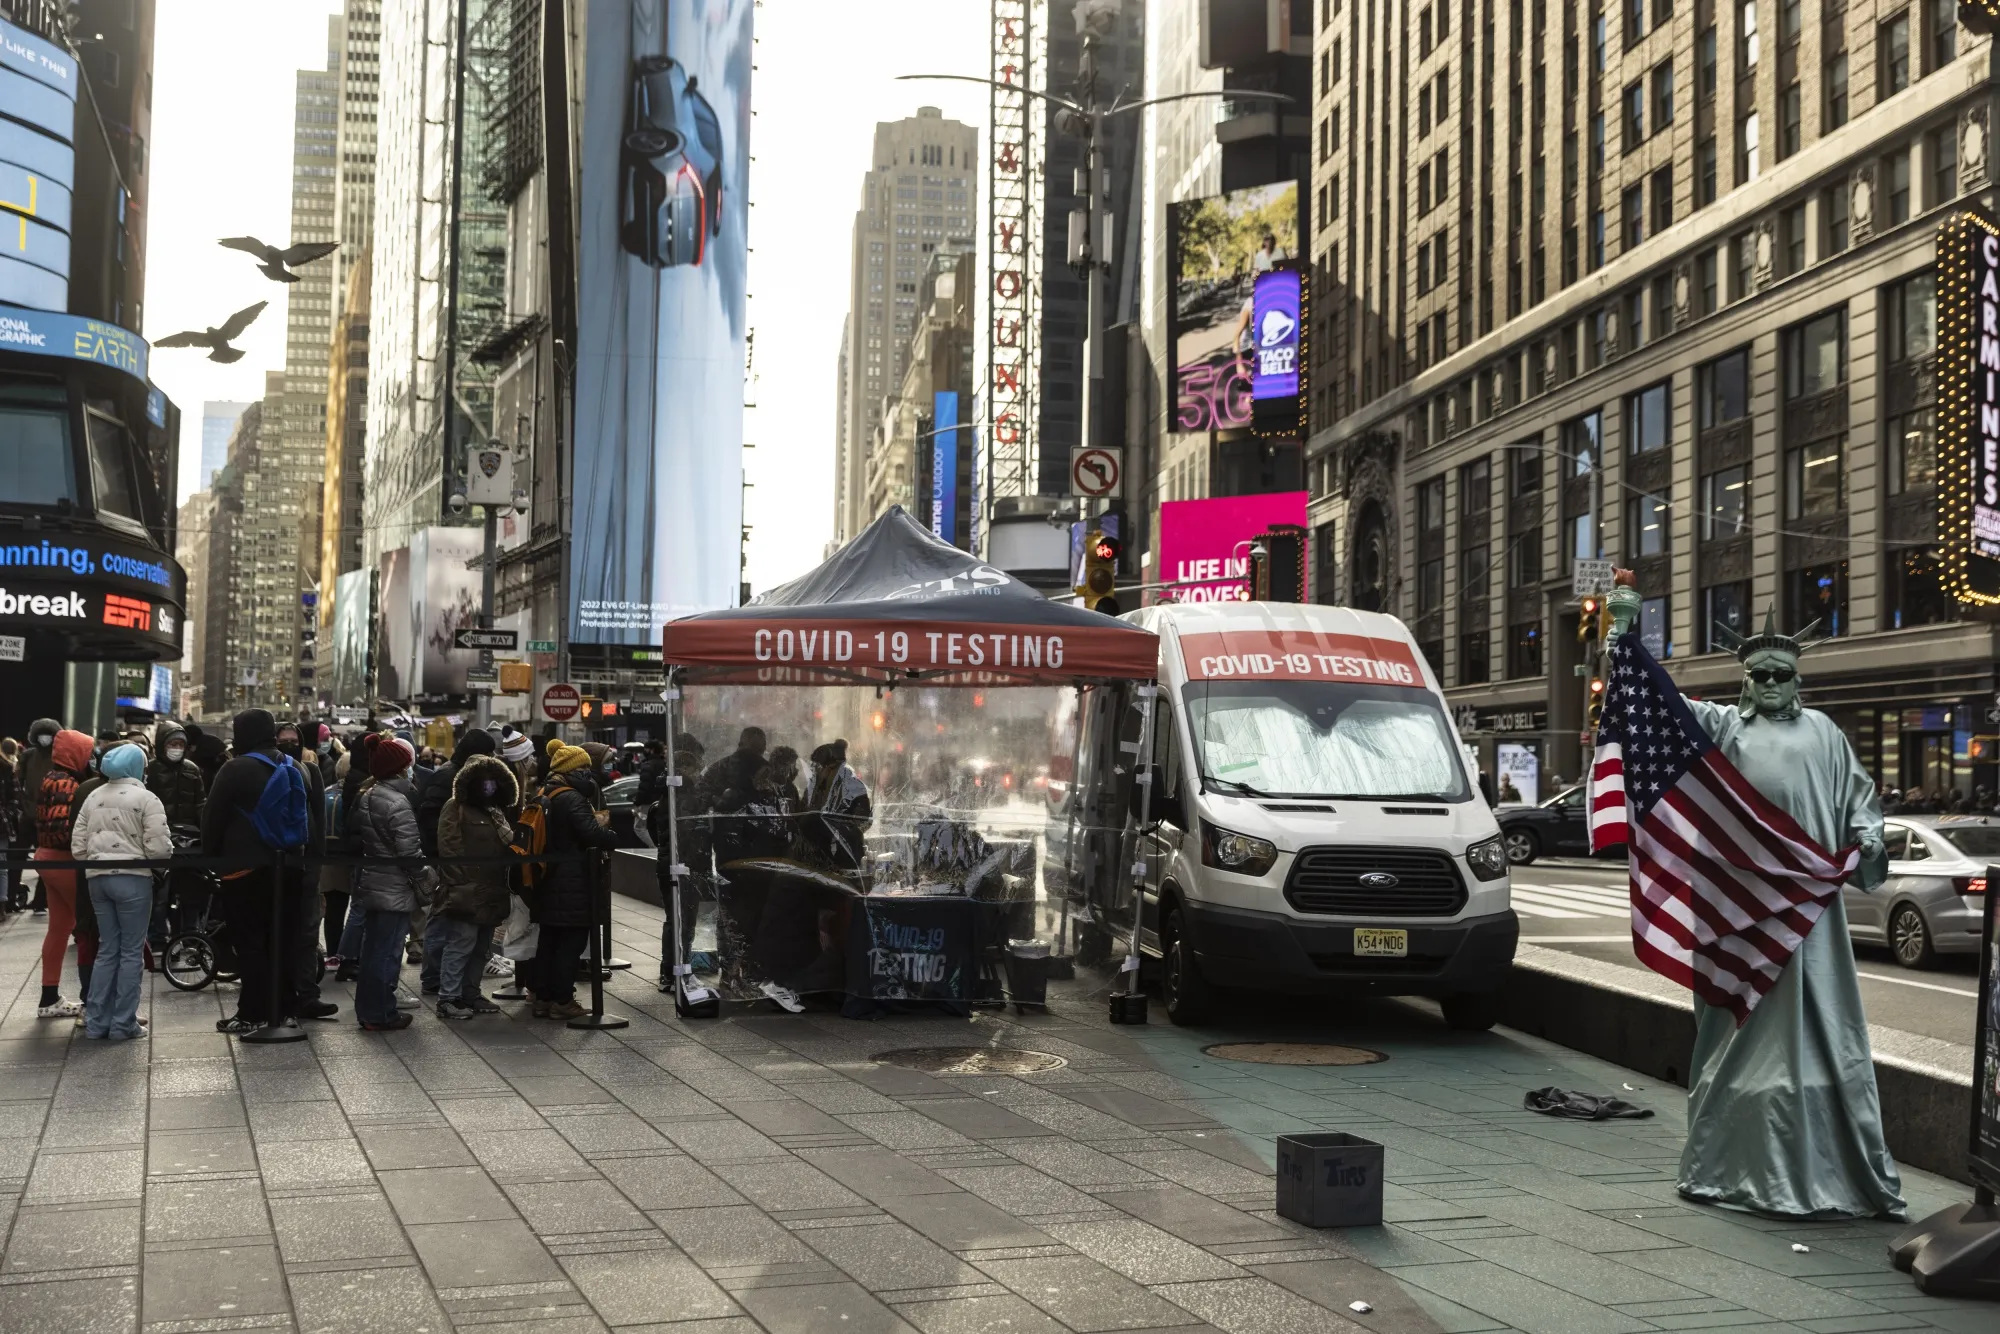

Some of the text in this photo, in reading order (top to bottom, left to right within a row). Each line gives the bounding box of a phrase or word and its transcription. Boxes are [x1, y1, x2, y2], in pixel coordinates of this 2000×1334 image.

[6, 38, 36, 62] LIKE
[40, 55, 67, 78] THIS
[996, 221, 1020, 443] YOUNG
[75, 331, 138, 373] EARTH
[1258, 346, 1294, 363] TACO
[1261, 358, 1294, 376] BELL
[1178, 360, 1253, 432] 5G
[0, 540, 95, 574] nning,
[1178, 557, 1248, 583] LIFE IN
[947, 587, 1001, 597] TESTING
[0, 588, 87, 619] break
[103, 593, 151, 631] ESPN
[581, 600, 601, 610] 2022
[602, 601, 618, 610] EV6
[618, 601, 649, 611] GT-Line
[581, 610, 613, 619] features
[613, 612, 631, 622] may
[631, 613, 651, 622] vary.
[581, 619, 628, 629] Professional
[628, 620, 651, 629] driver
[463, 635, 510, 644] ONE WAY
[527, 642, 534, 651] W
[536, 642, 548, 651] 44
[755, 629, 1064, 668] COVID-19 TESTING
[1200, 653, 1414, 684] COVID-19 TESTING
[1494, 714, 1513, 731] TACO
[1514, 712, 1534, 729] BELL
[1368, 875, 1391, 885] Ford
[1357, 935, 1404, 950] K54 NDG
[1281, 1151, 1303, 1182] TIPS
[1323, 1157, 1366, 1187] TIPS
